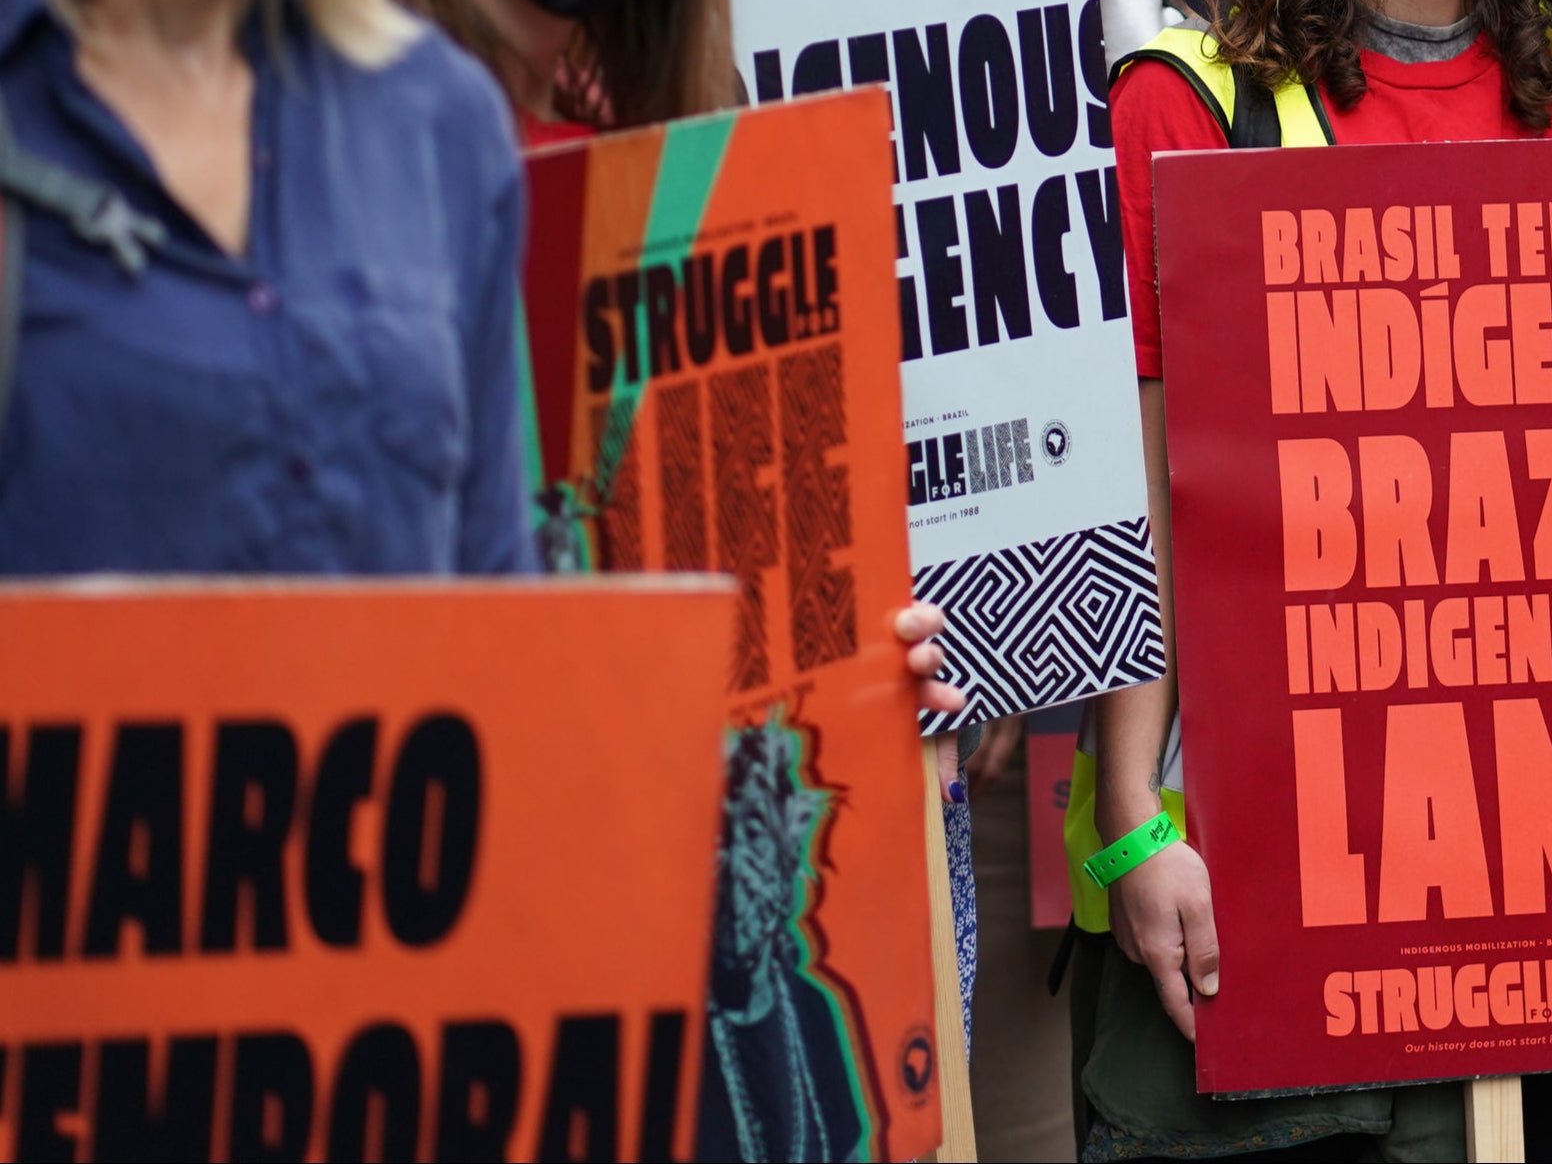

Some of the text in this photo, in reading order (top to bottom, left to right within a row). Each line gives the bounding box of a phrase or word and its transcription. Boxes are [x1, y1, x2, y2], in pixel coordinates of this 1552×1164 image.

[1262, 205, 1461, 286] BRASIL
[584, 223, 840, 394] STRUGGLE
[942, 409, 969, 421] BRAZIL
[965, 418, 1034, 494] LIFE
[931, 482, 962, 498] FOR
[908, 506, 980, 529] not start in 1988
[0, 712, 482, 963] MARCO
[1400, 944, 1462, 955] INDIGENOUS
[1465, 940, 1536, 952] MOBILIZATION
[1404, 1044, 1426, 1054] Our
[1428, 1039, 1467, 1053] history
[1469, 1039, 1496, 1049] does
[1499, 1035, 1517, 1047] not
[1520, 1032, 1547, 1045] start
